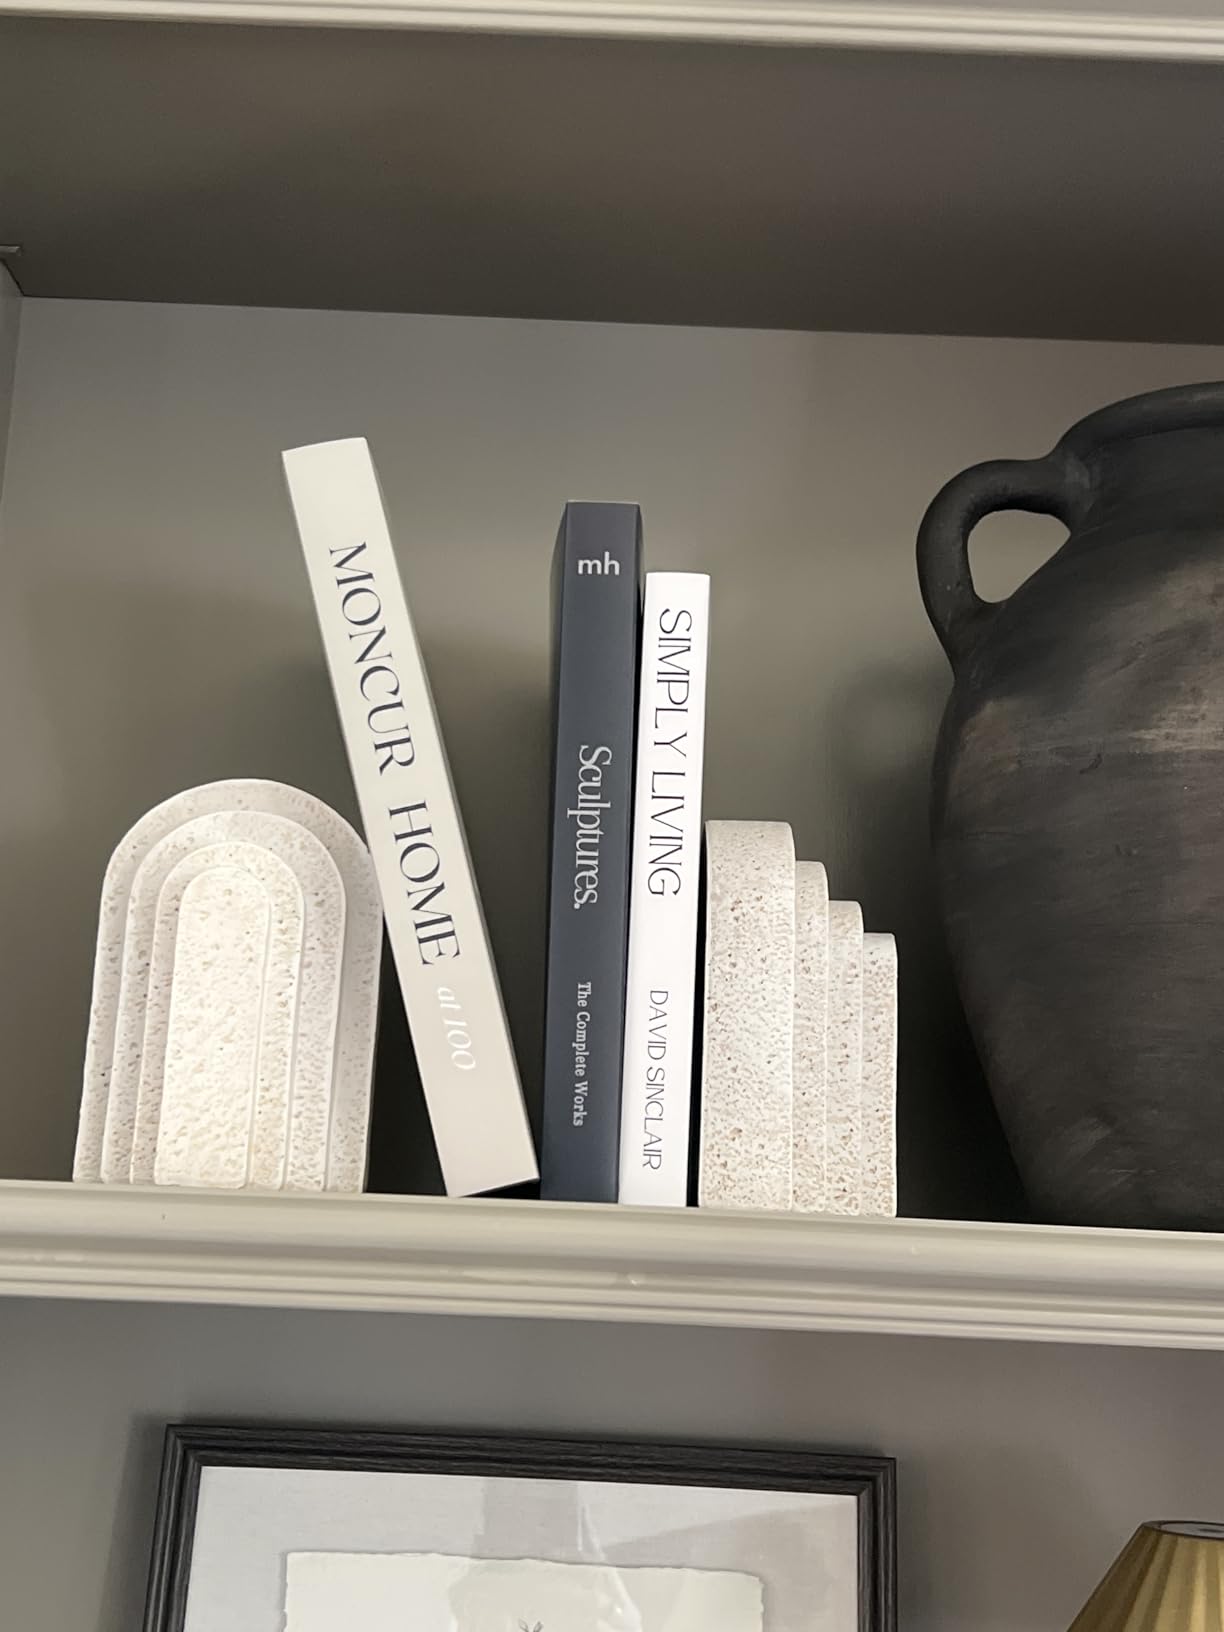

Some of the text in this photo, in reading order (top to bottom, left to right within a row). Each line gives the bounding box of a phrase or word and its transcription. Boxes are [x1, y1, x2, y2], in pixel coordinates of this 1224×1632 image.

[577, 551, 620, 576] mh
[329, 541, 477, 1071] MONCUR HOME at 100
[567, 744, 613, 910] Sculptures.
[648, 608, 692, 896] SIMPLY LIVING
[572, 981, 592, 1127] The Complete Works
[642, 990, 669, 1170] DAVID SINCLAIR
